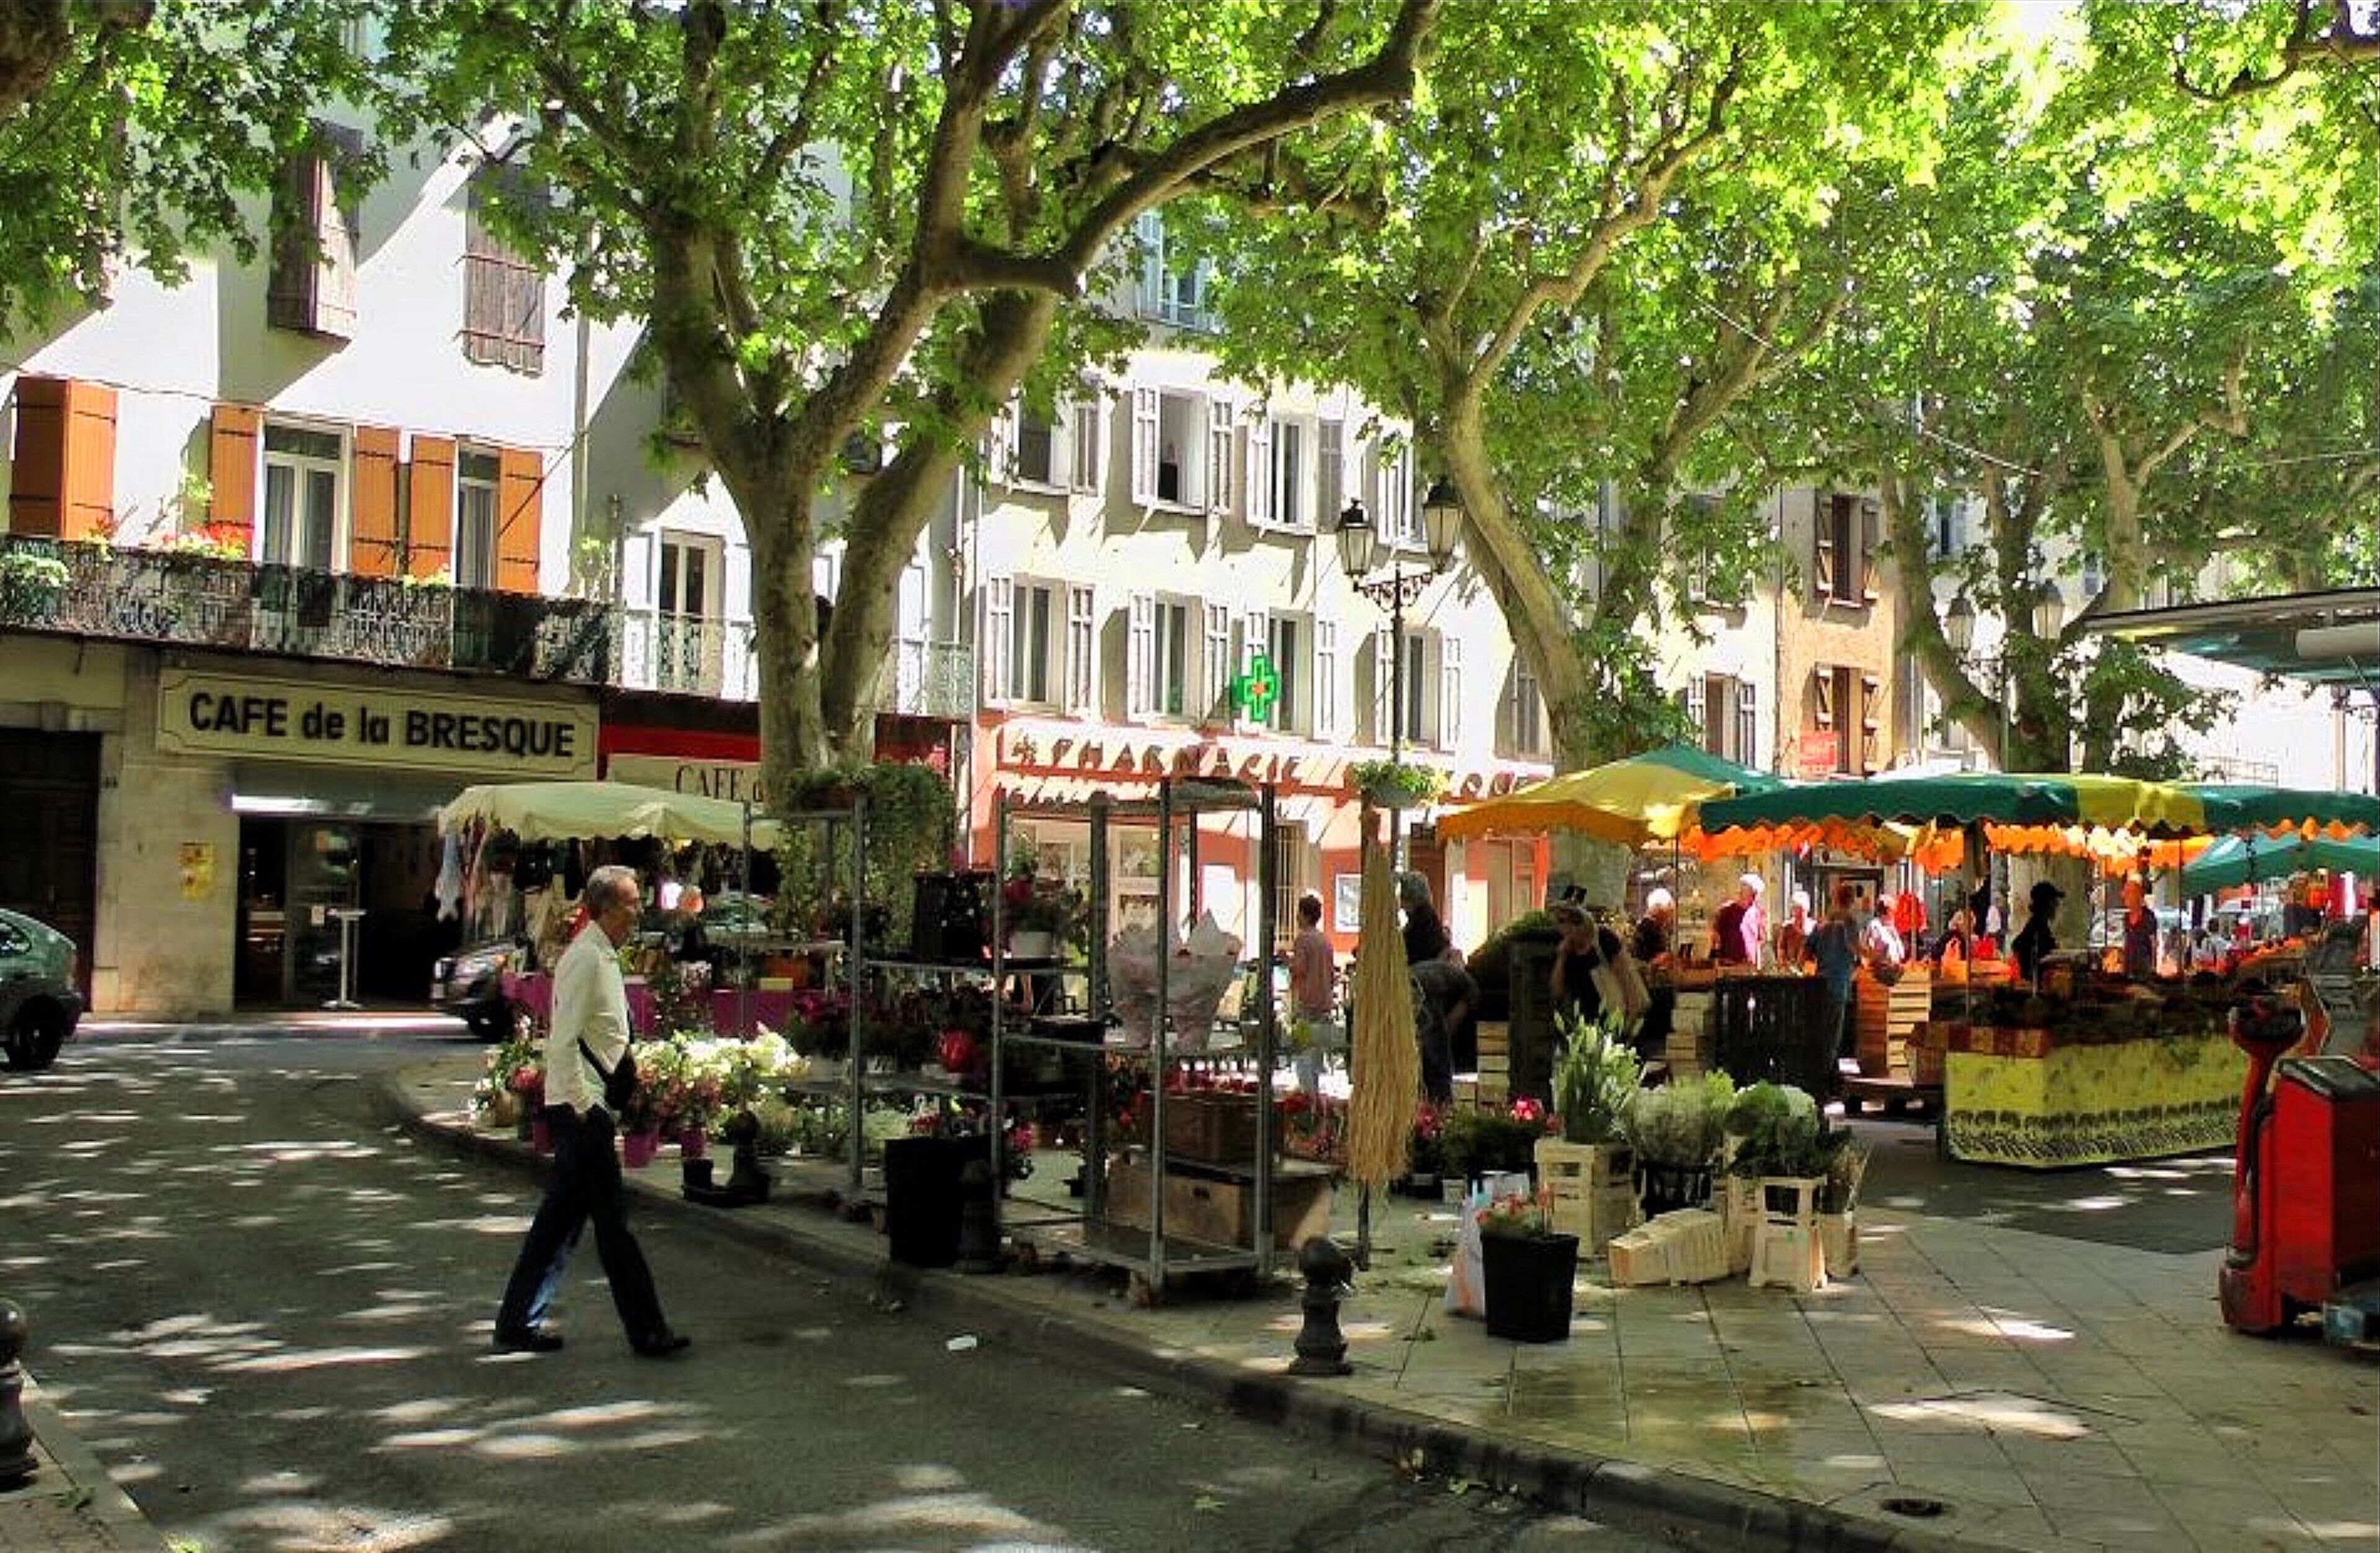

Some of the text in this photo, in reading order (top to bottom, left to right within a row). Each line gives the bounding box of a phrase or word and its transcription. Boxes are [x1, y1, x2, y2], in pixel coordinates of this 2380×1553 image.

[190, 692, 575, 757] CAFE de la BRESQUE
[1052, 737, 1302, 781] PHARMACIE
